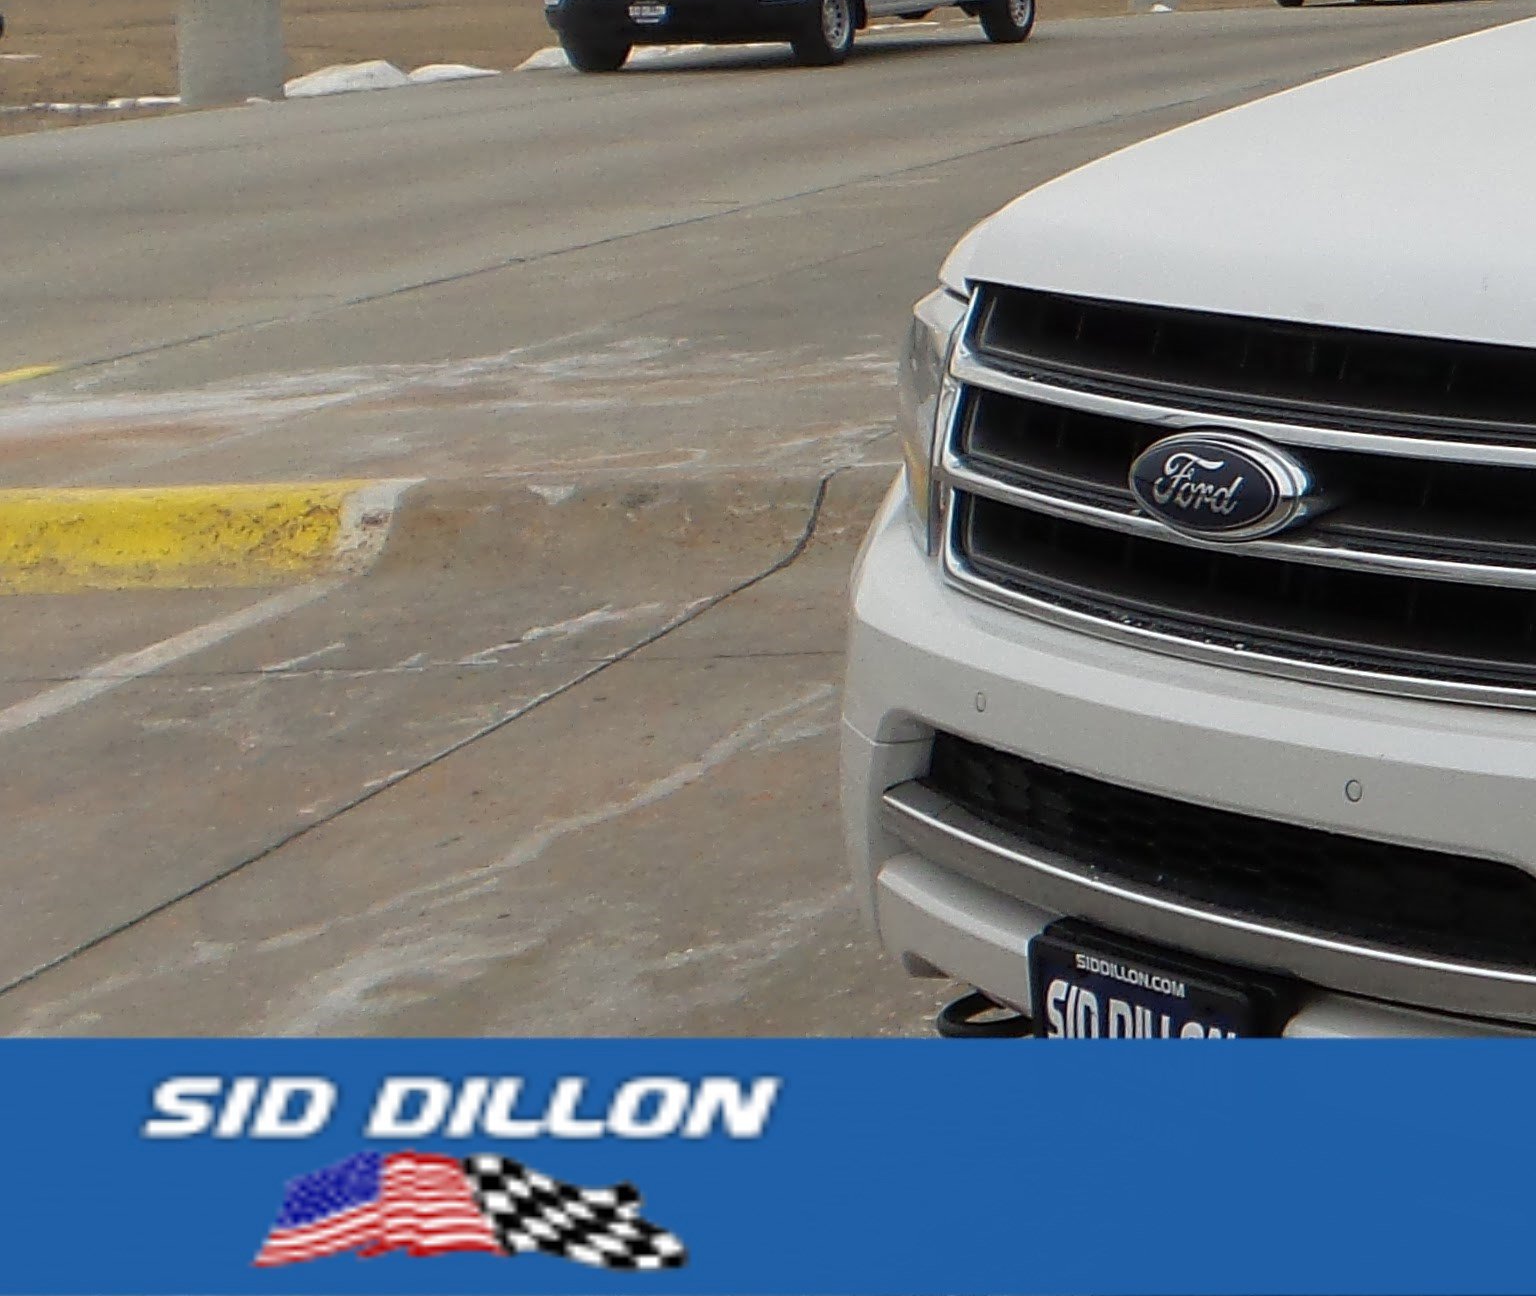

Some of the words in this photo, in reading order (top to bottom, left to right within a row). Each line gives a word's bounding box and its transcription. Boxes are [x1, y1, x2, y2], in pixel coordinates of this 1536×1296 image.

[1152, 451, 1245, 516] Ford
[1074, 953, 1187, 999] SIDDILLON.COM
[1046, 978, 1099, 1039] SID
